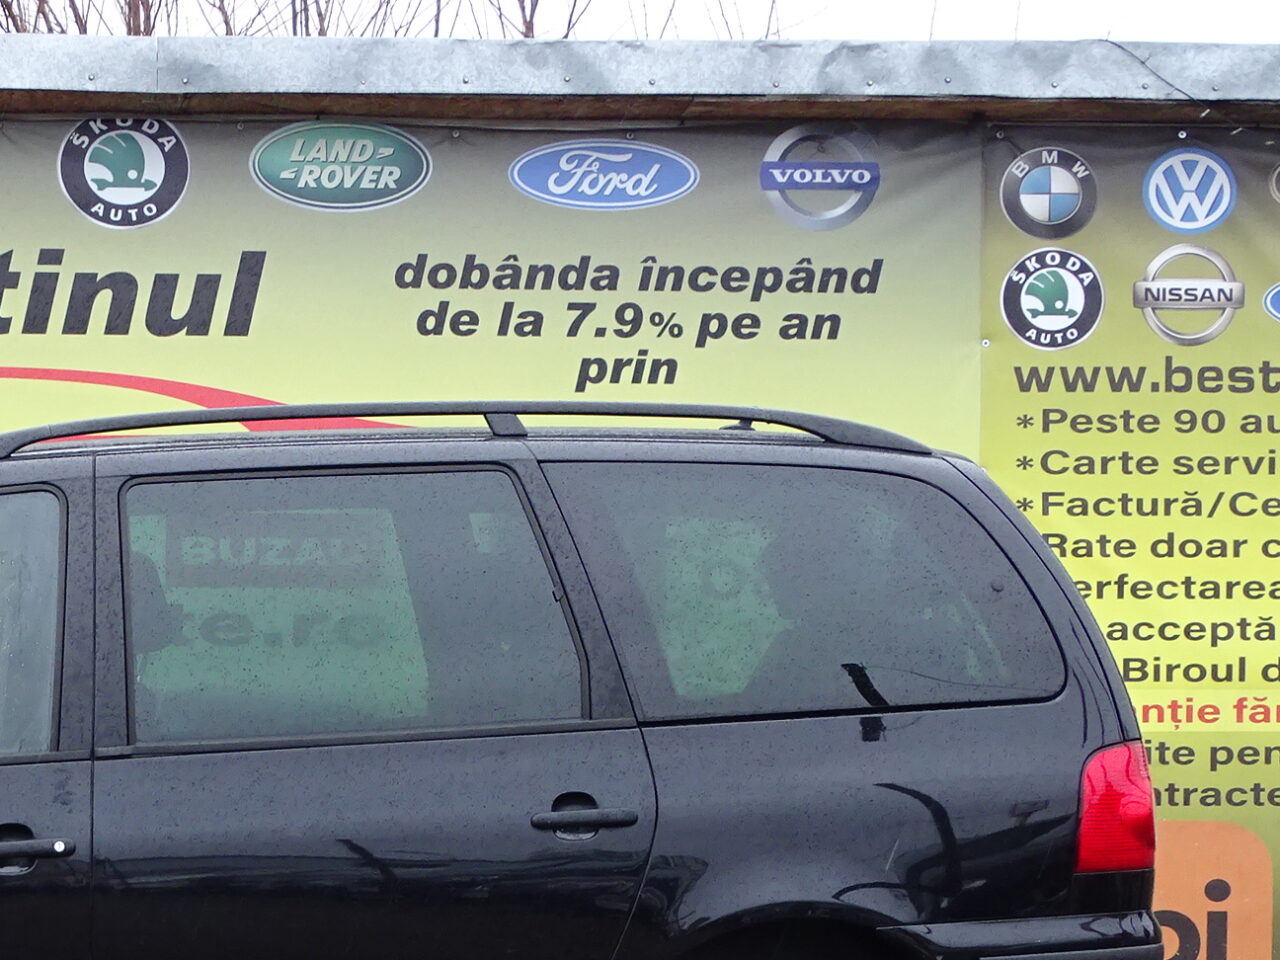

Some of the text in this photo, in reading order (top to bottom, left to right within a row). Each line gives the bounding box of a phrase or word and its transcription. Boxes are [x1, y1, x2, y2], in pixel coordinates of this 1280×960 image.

[290, 139, 373, 164] LAND
[1011, 150, 1090, 178] BMW
[297, 164, 401, 190] ROVER
[546, 150, 659, 198] Ford
[769, 169, 871, 184] VOLVO
[91, 204, 157, 221] AUTO
[394, 254, 884, 301] dobânda începând
[1144, 287, 1233, 302] NISSAN
[417, 301, 841, 348] de la 7.9% pe an
[1025, 328, 1078, 344] AUTO
[575, 349, 677, 392] prin
[1174, 409, 1226, 434] 90
[1173, 449, 1276, 475] servi
[1150, 532, 1248, 558] doar
[1106, 616, 1275, 647] acceptă
[1123, 656, 1246, 682] Biroul
[1133, 697, 1220, 730] nție
